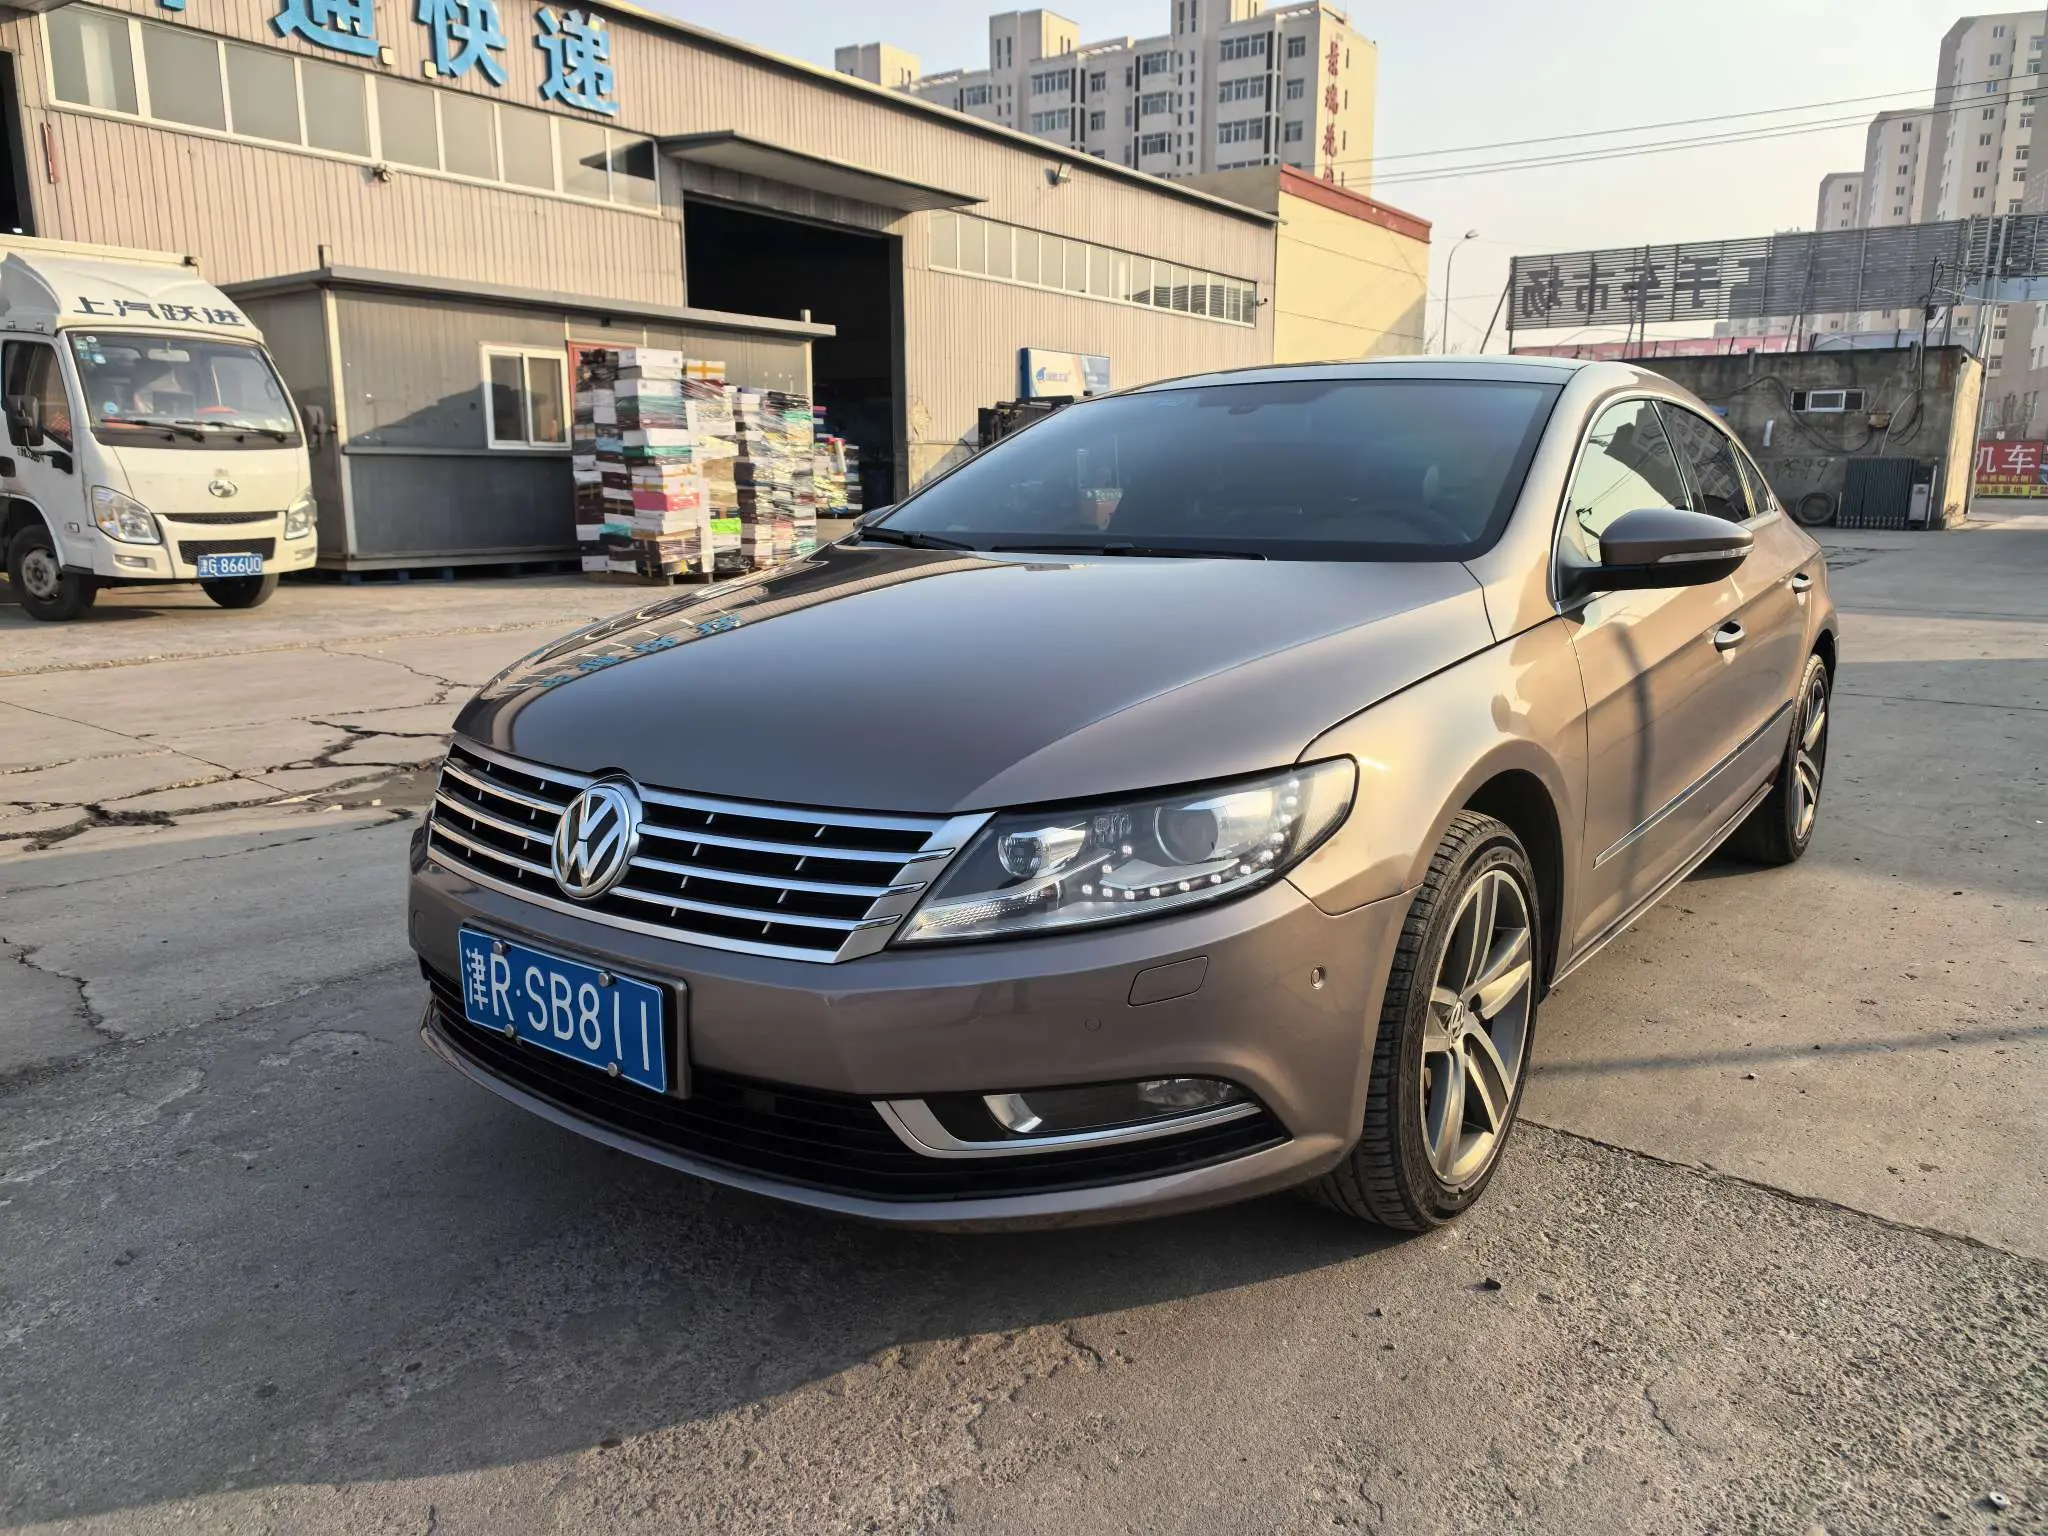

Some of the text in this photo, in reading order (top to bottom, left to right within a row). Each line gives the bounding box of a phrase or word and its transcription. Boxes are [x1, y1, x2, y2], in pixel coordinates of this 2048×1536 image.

[73, 296, 246, 327] 上汽跃进
[466, 948, 650, 1072] 津R·SB811
